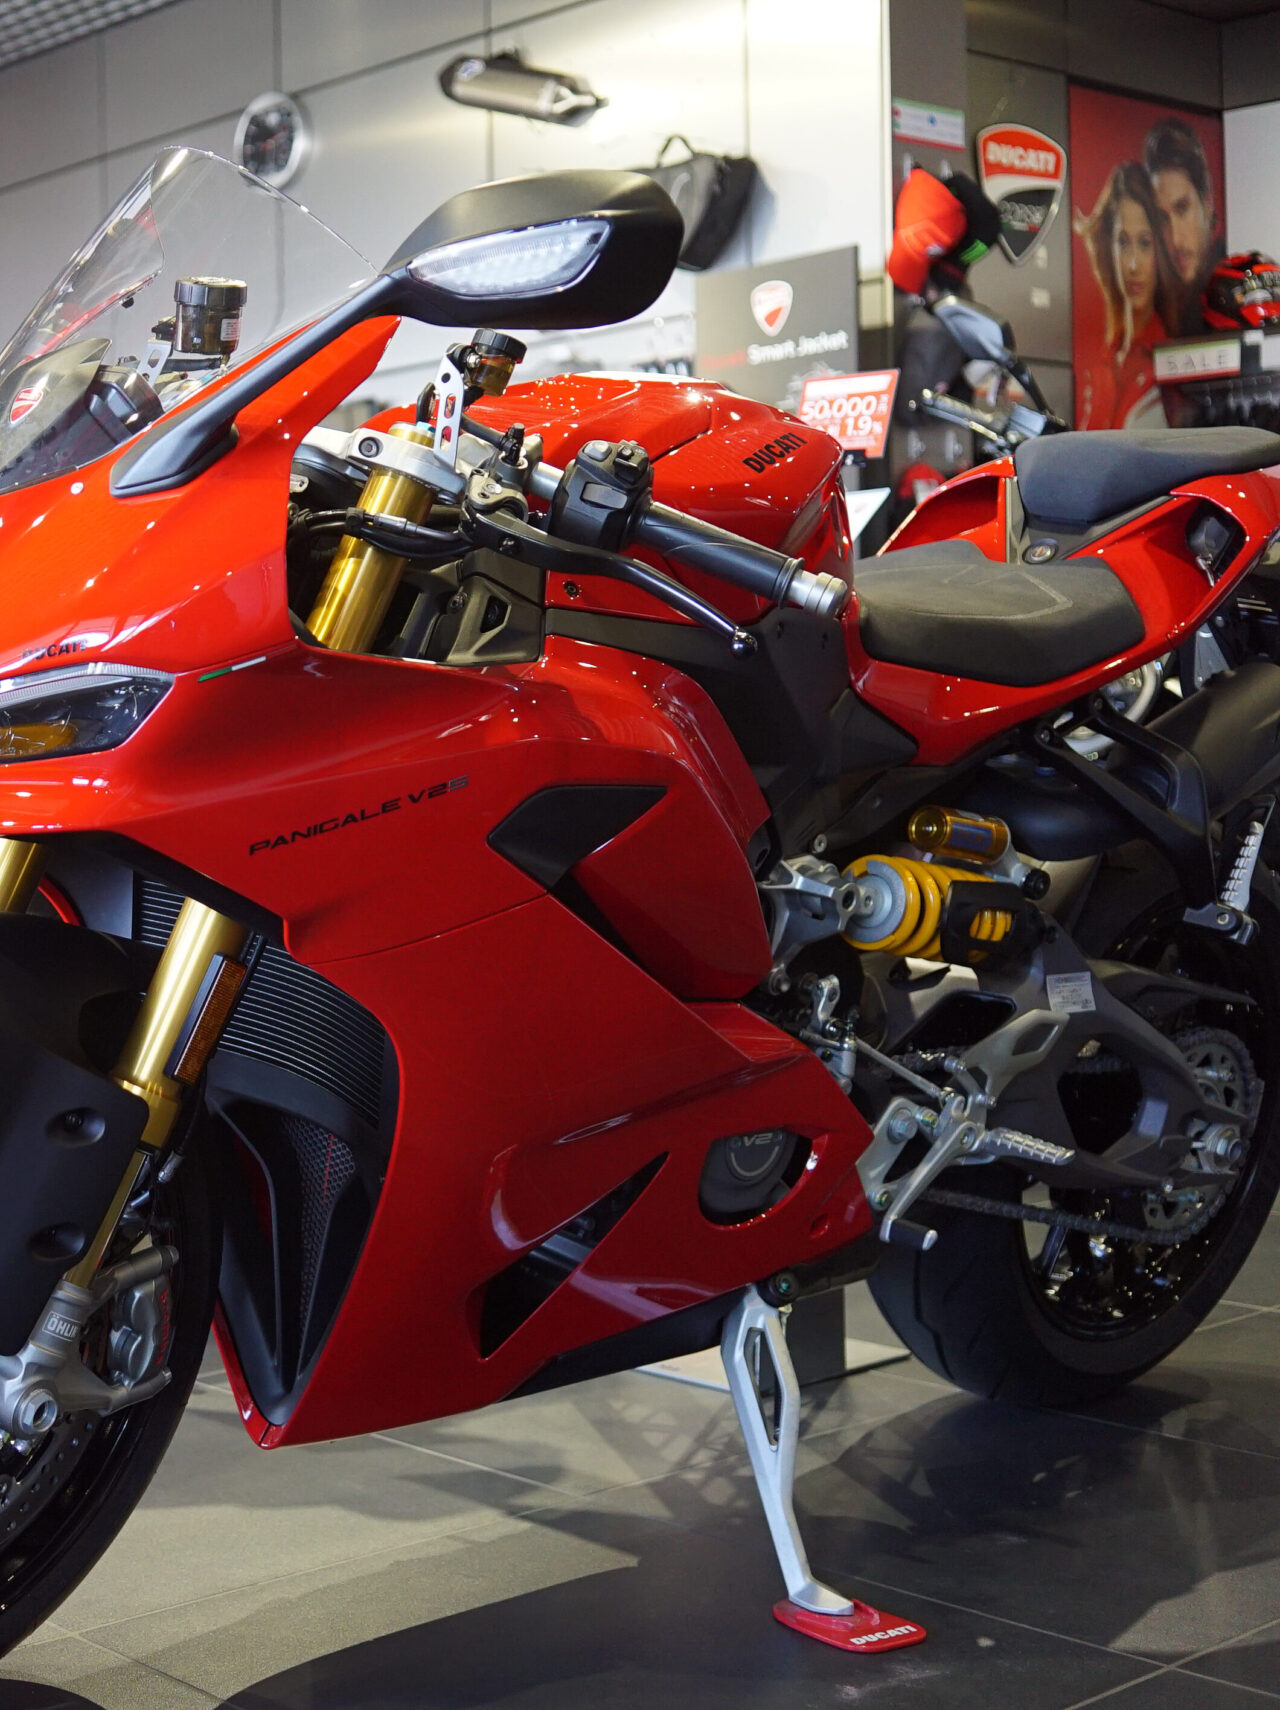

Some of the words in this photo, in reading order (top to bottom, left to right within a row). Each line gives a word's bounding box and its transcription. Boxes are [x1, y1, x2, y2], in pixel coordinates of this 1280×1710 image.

[986, 140, 1056, 174] DUCATI
[747, 338, 796, 366] Smart
[797, 329, 849, 356] Jacket
[801, 395, 877, 421] 50,000
[742, 432, 808, 474] DUCATI
[249, 797, 402, 856] PANIGALE
[743, 1132, 774, 1146] V2
[849, 1624, 918, 1646] DUCATI
